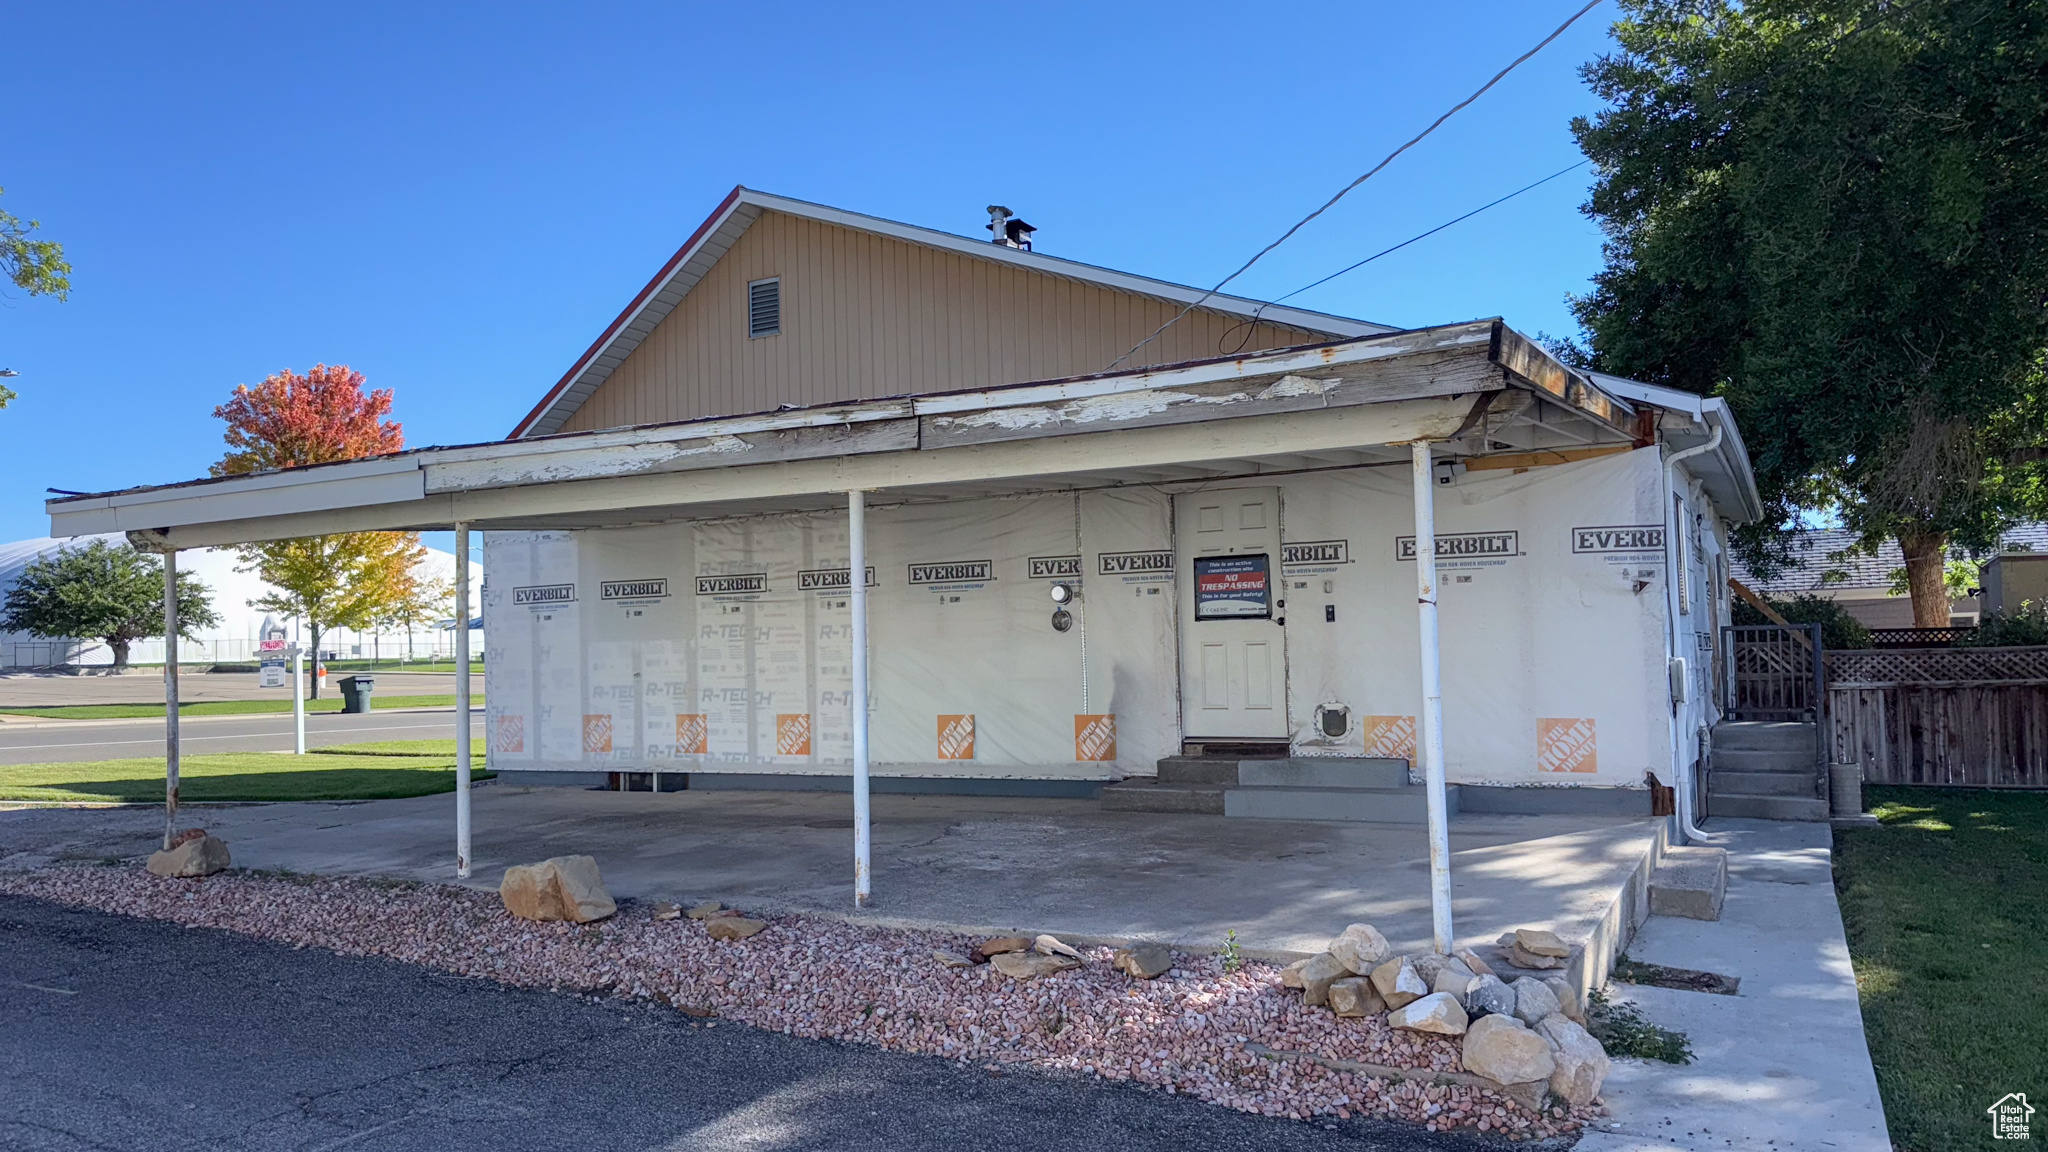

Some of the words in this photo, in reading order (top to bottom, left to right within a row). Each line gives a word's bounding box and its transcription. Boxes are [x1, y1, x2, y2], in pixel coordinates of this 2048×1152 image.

[1402, 535, 1512, 557] EERBILT
[1578, 529, 1665, 549] EVERB
[912, 563, 988, 581] EVERBILT
[1224, 574, 1239, 582] NO
[604, 582, 664, 597] EVERBILT
[699, 577, 764, 592] EVERBILT
[1201, 580, 1264, 591] TRESPASSING
[516, 587, 572, 602] EVERBILT
[1543, 723, 1567, 744] THE
[1537, 718, 1596, 772] HOME
[1561, 739, 1597, 772] DEPOT
